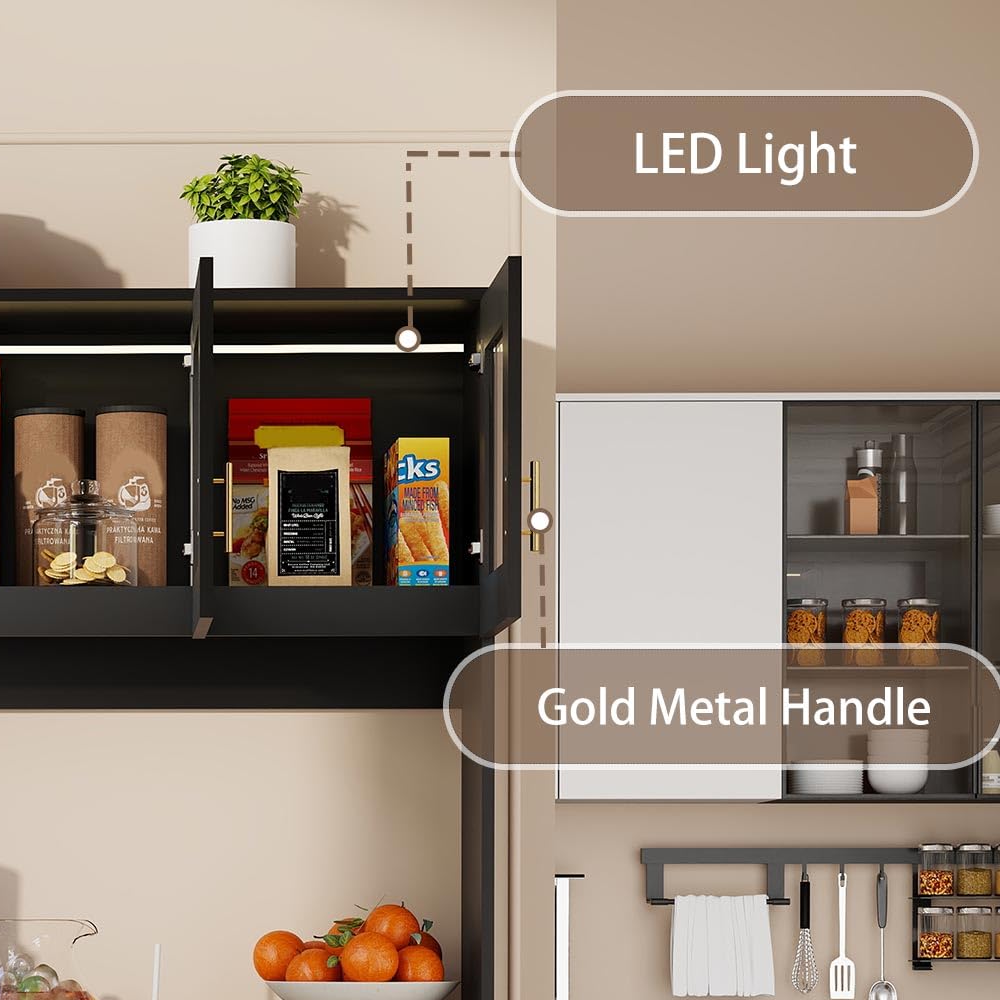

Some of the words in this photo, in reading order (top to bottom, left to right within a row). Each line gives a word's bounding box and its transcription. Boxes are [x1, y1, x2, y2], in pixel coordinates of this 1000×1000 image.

[403, 487, 421, 498] MADE
[422, 486, 440, 498] FROM
[402, 498, 425, 511] MINCED
[247, 567, 258, 579] 14
